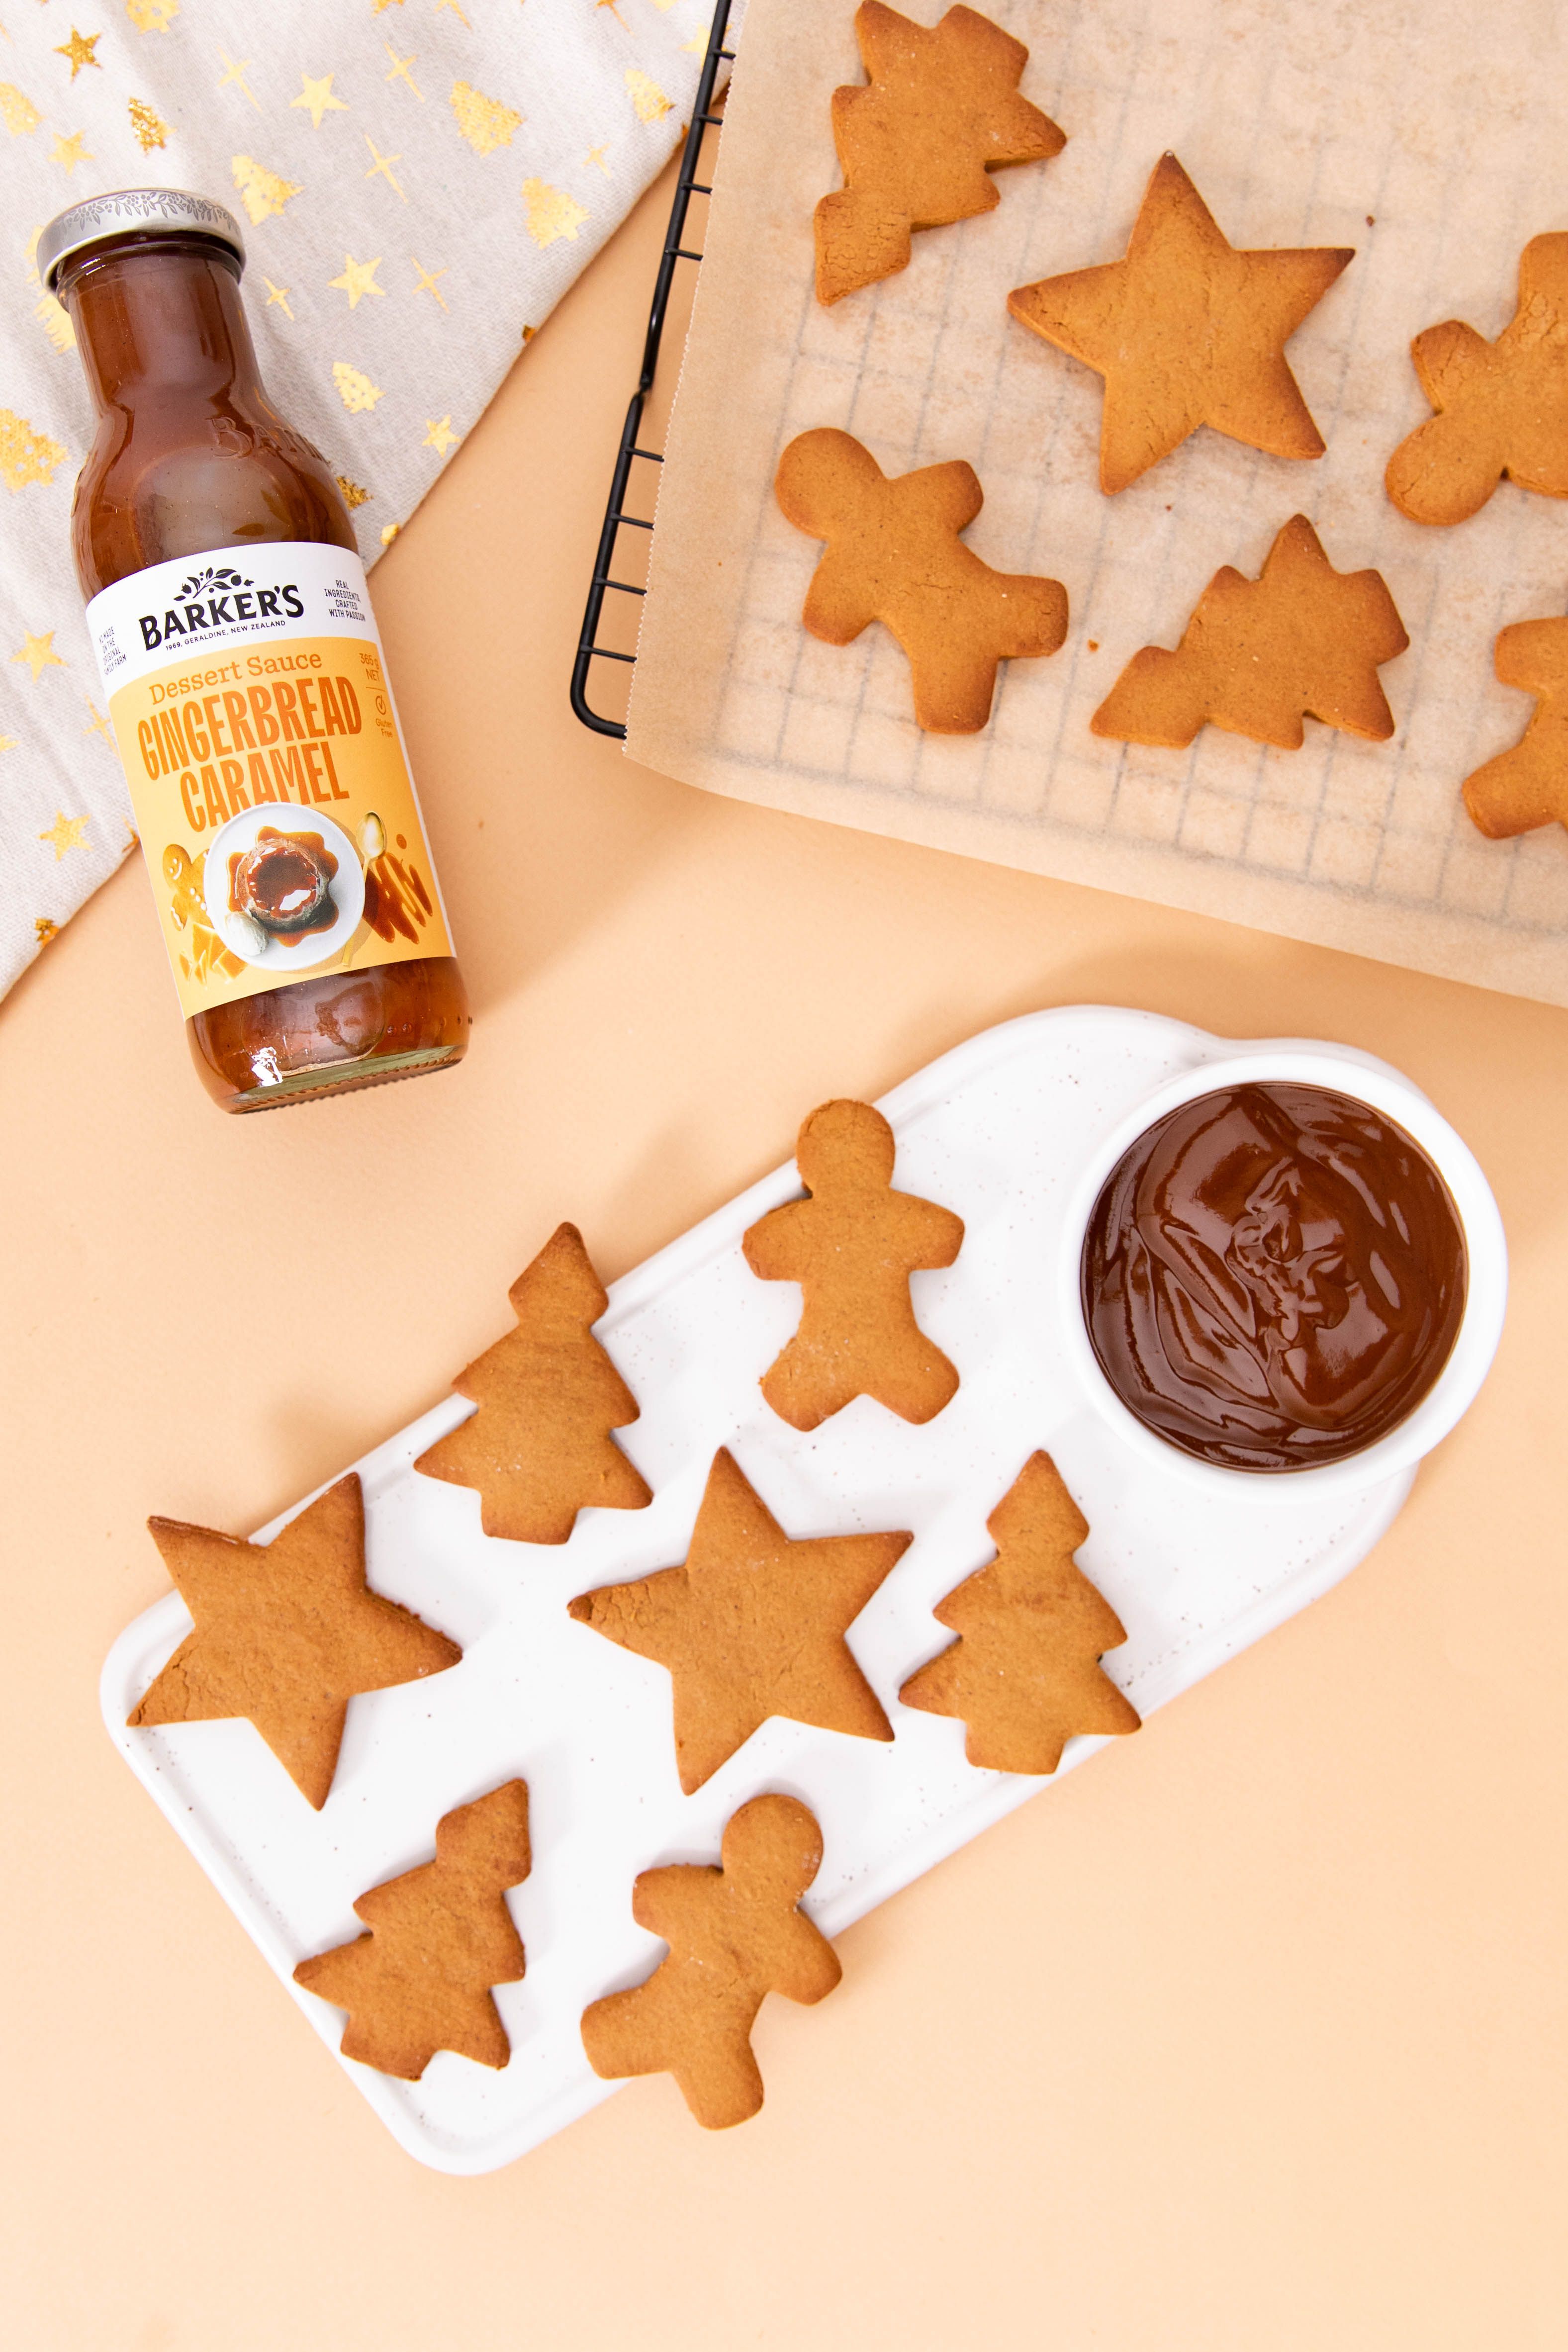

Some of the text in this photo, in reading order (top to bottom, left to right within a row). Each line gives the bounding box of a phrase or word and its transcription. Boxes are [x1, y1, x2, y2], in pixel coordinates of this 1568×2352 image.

[335, 579, 349, 590] REAL
[335, 599, 358, 611] CRAFTED
[139, 585, 305, 651] BARKER'S
[328, 608, 345, 618] WITH
[103, 626, 114, 639] MADE
[165, 620, 286, 651] 1969, GERALDINE, NEW ZEALAND
[107, 637, 115, 649] THE
[114, 653, 127, 668] FARM
[359, 652, 373, 666] 365
[149, 653, 323, 705] Dessert Sauce
[366, 668, 380, 681] NET
[137, 676, 363, 781] GINGERBREAD
[180, 741, 351, 833] CARAMEL
